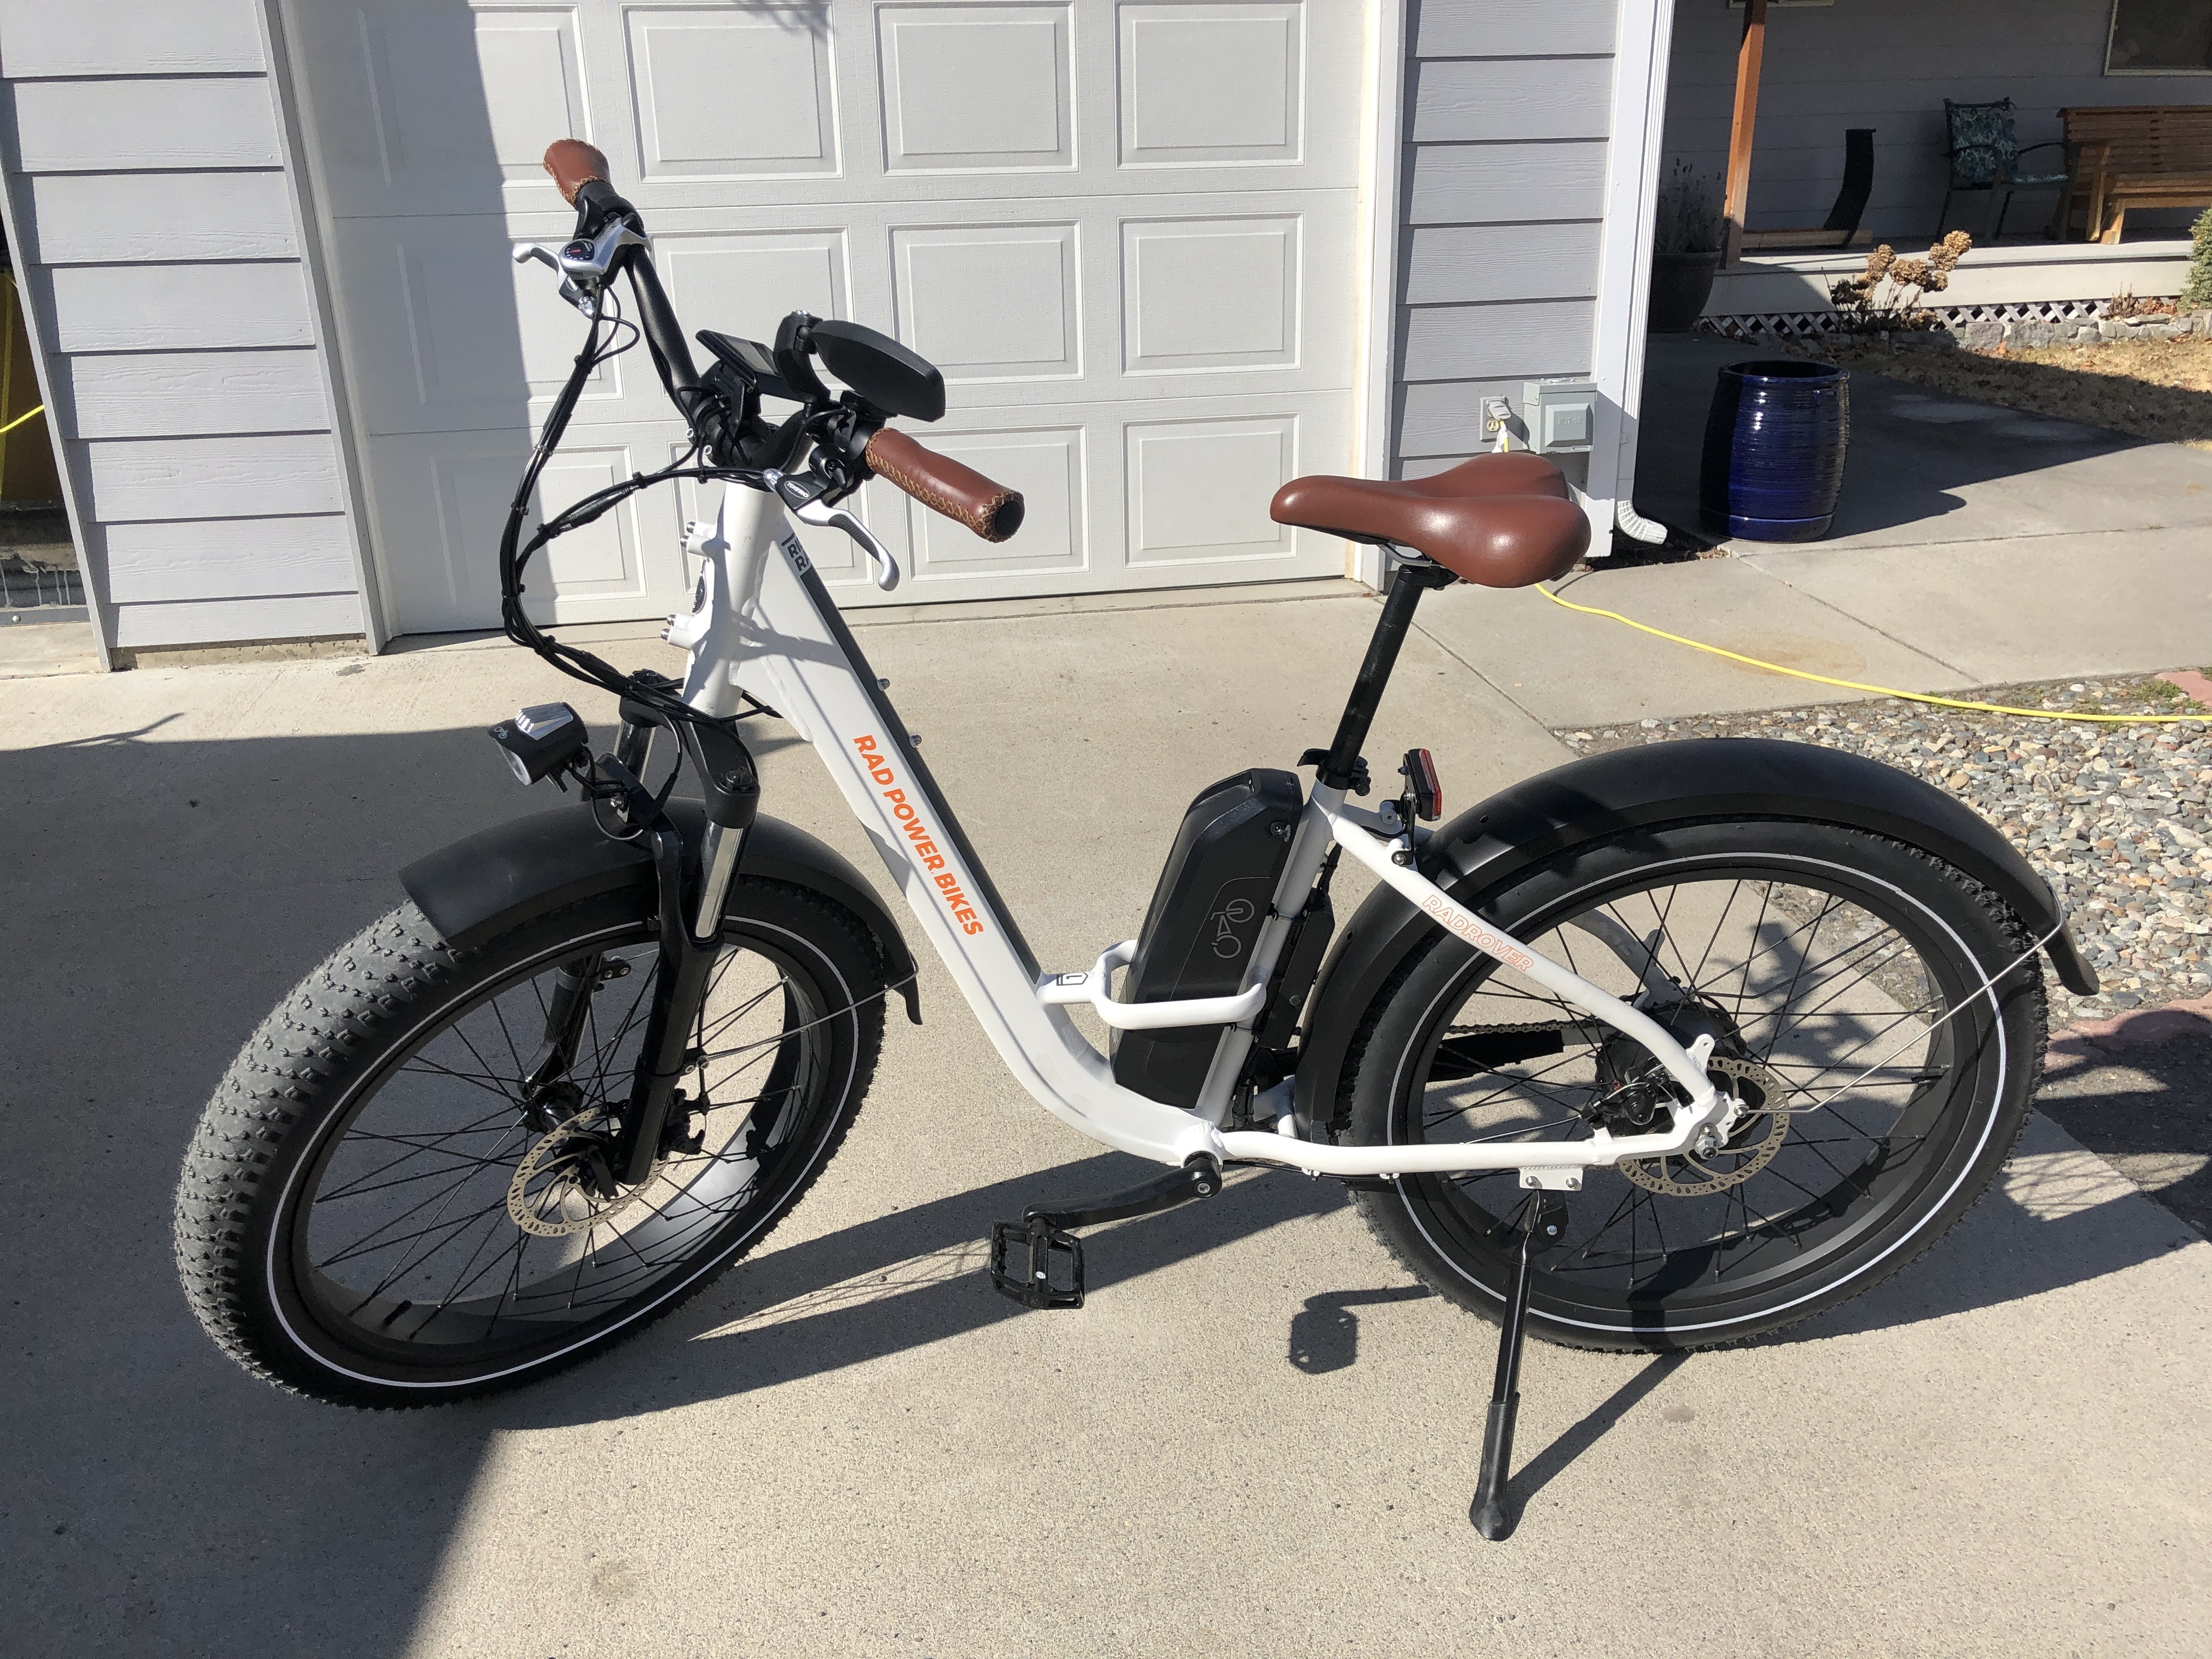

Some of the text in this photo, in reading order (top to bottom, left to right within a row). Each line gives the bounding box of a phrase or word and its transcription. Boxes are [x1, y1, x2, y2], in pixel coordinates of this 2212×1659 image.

[854, 735, 984, 935] RAD POWER BIKES
[1421, 894, 1534, 972] RADROVER
